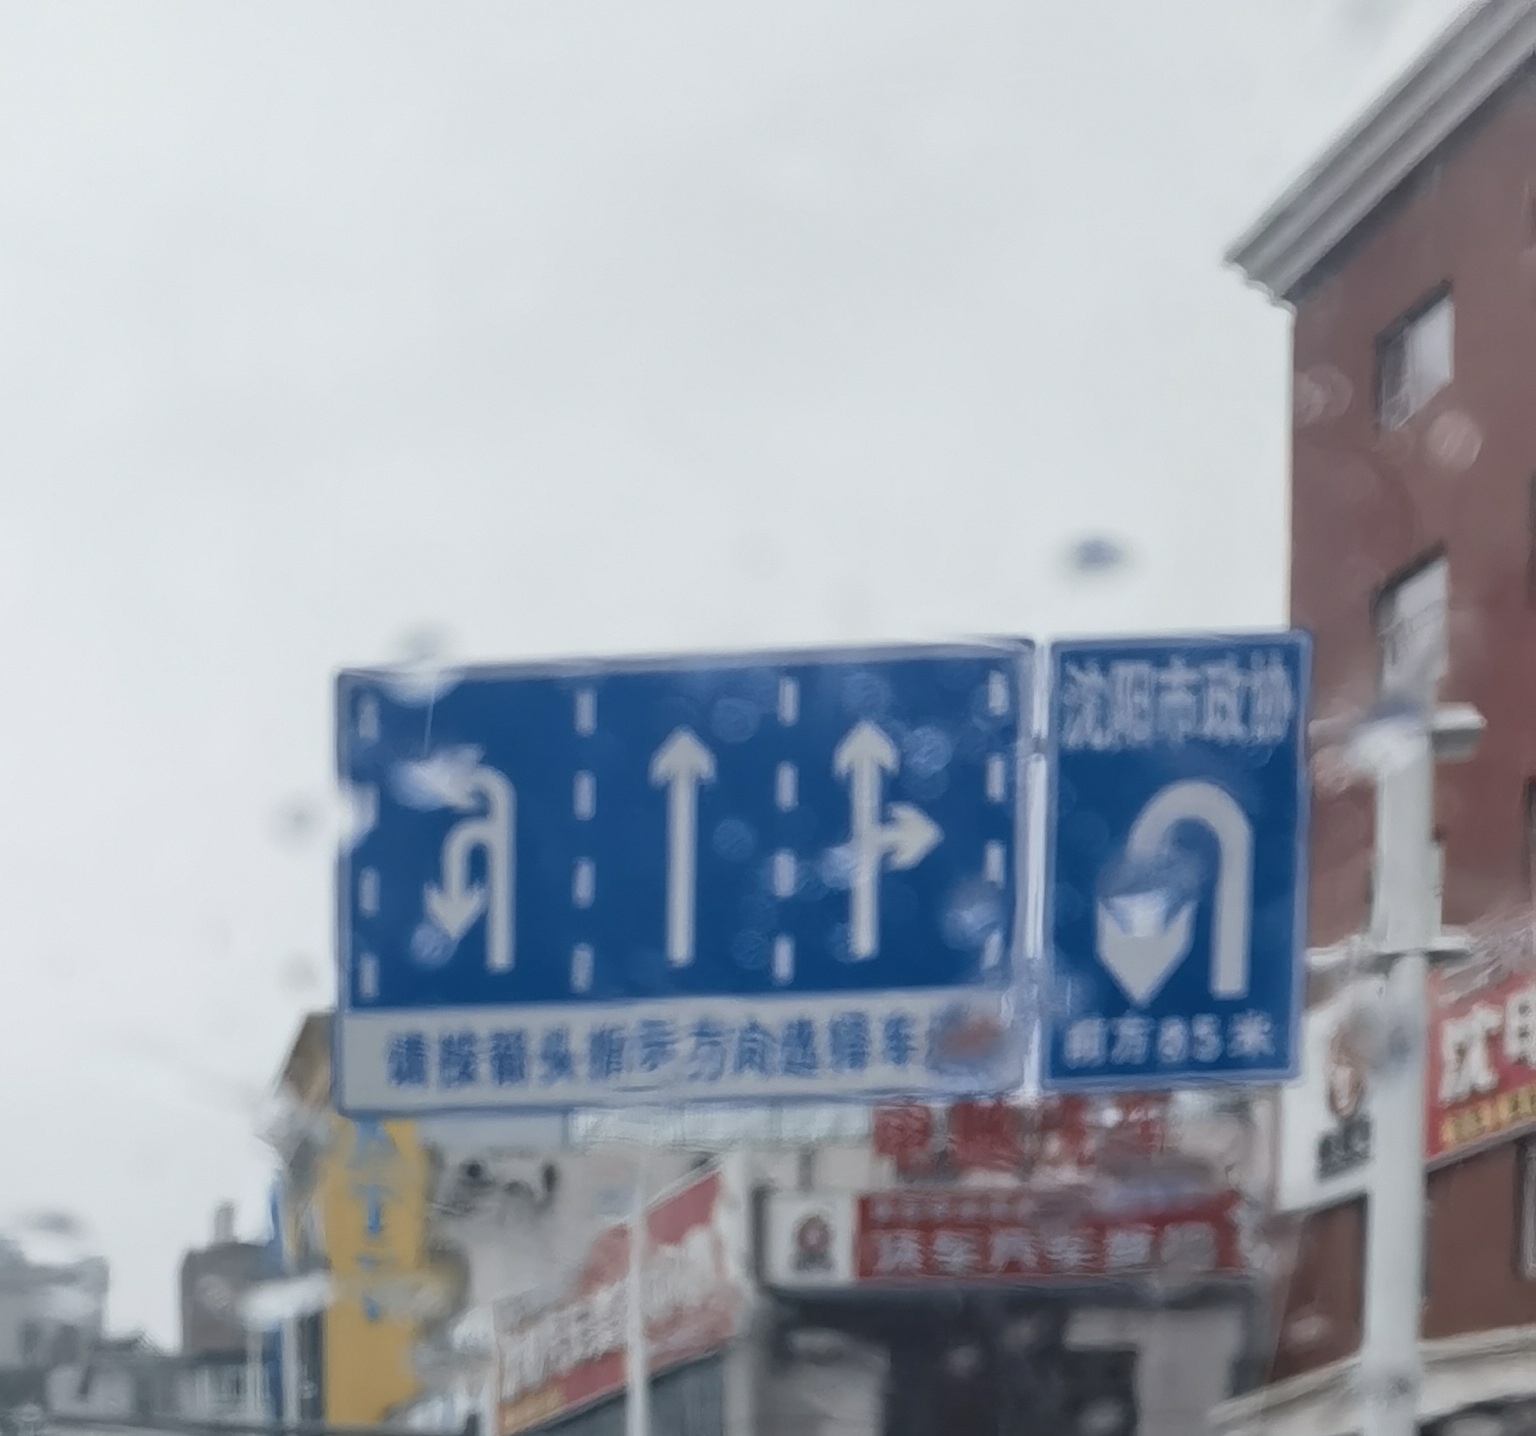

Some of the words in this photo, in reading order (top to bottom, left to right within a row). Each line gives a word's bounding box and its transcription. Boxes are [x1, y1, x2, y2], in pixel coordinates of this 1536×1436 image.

[1062, 653, 1293, 750] 沈阳市政协
[386, 1010, 1004, 1090] 请按箭头指示方向选择车
